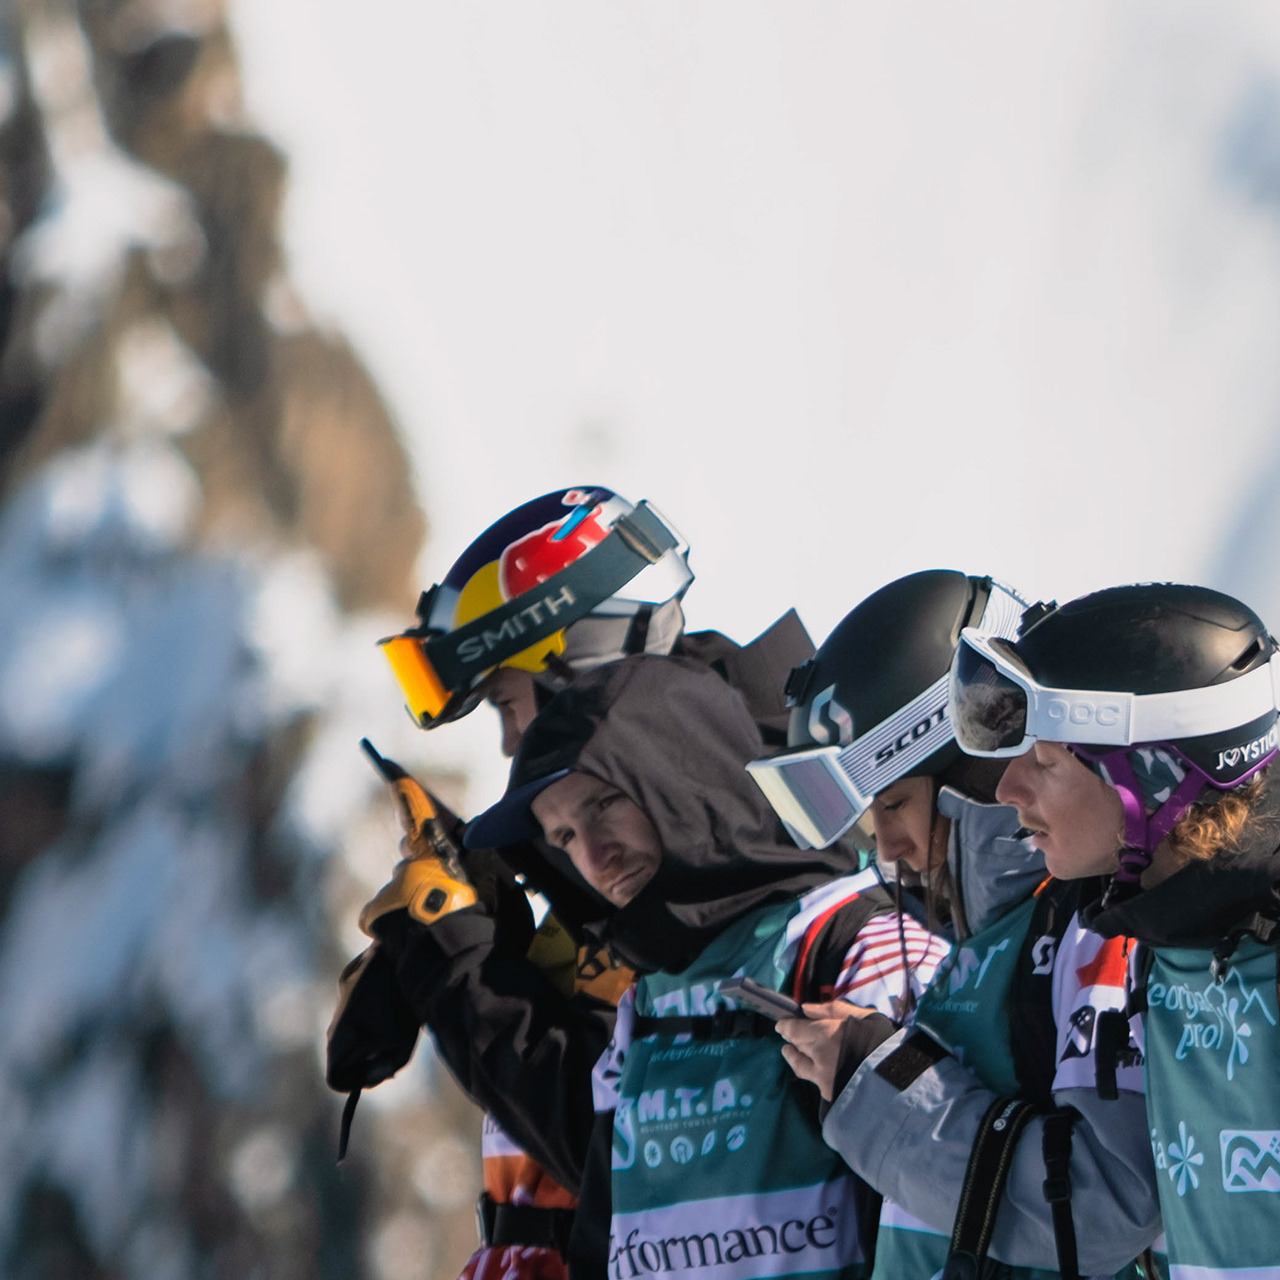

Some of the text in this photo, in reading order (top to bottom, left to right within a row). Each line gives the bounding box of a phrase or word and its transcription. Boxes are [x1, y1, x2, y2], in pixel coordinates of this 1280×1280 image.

[455, 585, 577, 663] SMITH
[1148, 975, 1213, 1019] eorgia
[637, 1078, 755, 1124] M.T.A.
